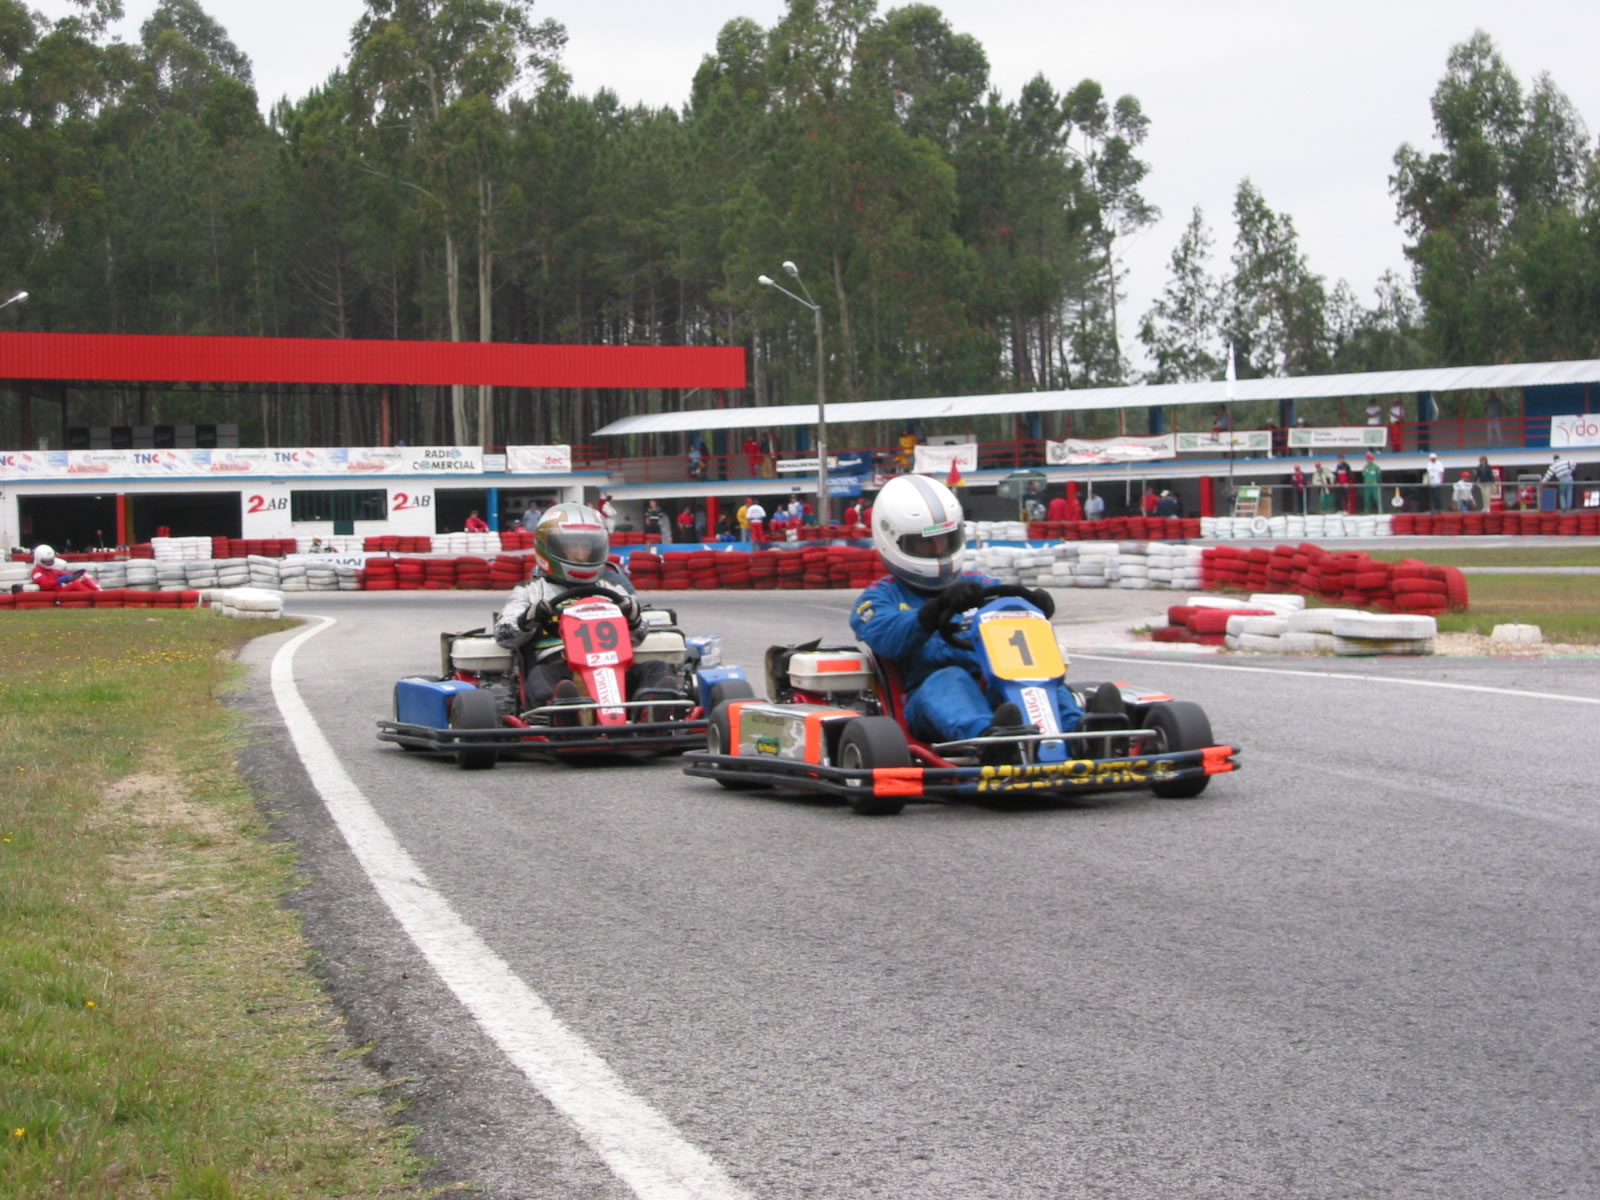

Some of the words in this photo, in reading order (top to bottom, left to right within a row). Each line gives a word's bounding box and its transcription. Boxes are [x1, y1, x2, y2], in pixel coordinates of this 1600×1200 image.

[134, 453, 160, 464] TNC
[273, 452, 300, 462] TNC
[574, 620, 618, 653] 19
[1008, 629, 1034, 666] 1
